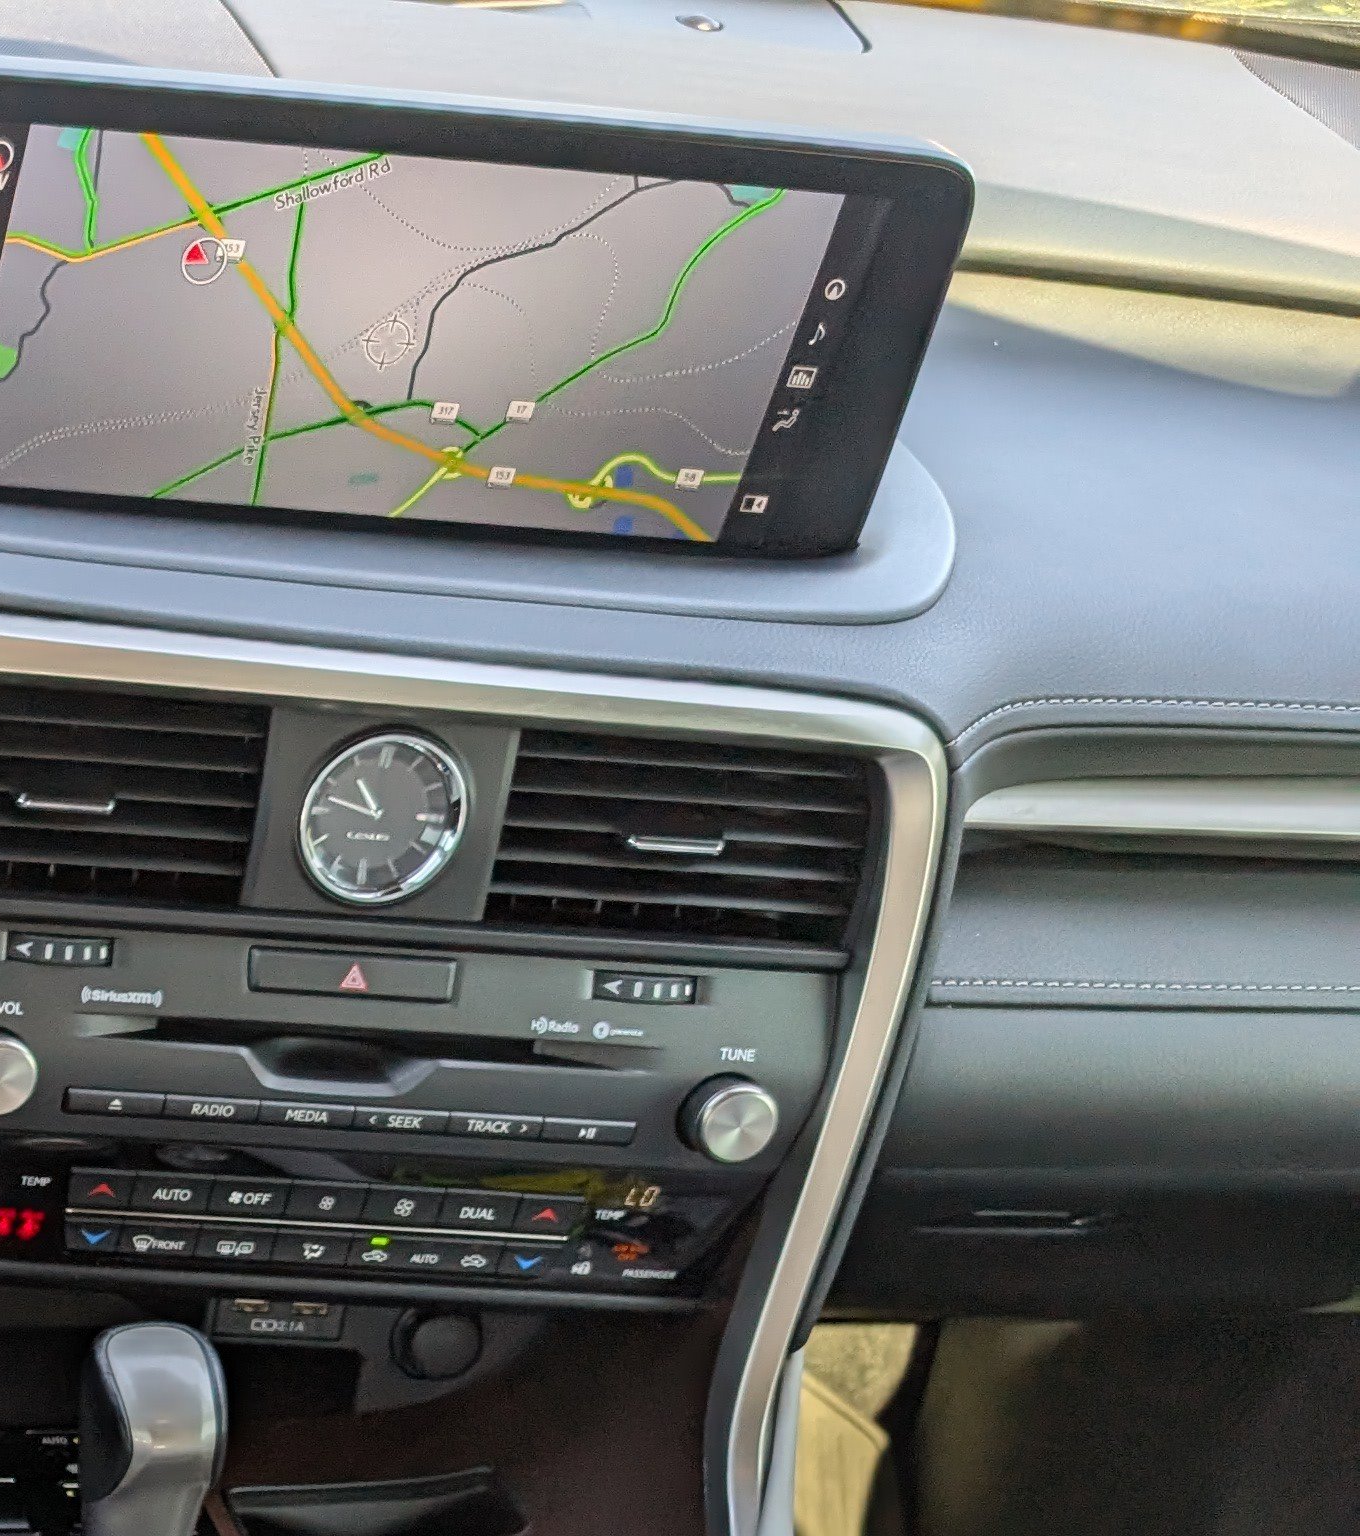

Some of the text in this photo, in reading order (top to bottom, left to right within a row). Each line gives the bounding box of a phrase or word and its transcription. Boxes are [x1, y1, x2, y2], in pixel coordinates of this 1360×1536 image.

[274, 158, 393, 211] Shallowford Rd
[243, 387, 268, 465] Jersey Pike
[547, 1018, 580, 1034] Radio
[719, 1046, 757, 1063] TUNE
[190, 1102, 235, 1118] RADIO
[285, 1108, 329, 1124] MEDIA
[386, 1114, 424, 1130] SEEK
[466, 1118, 510, 1135] TRACK
[20, 1175, 53, 1188] TEMP
[152, 1187, 192, 1202] AUTO
[242, 1192, 273, 1206] OFF
[458, 1204, 497, 1221] DUAL
[594, 1208, 627, 1222] TEMP
[151, 1239, 186, 1252] FRONT
[409, 1252, 439, 1265] AUTO
[41, 1435, 68, 1445] AUTO
